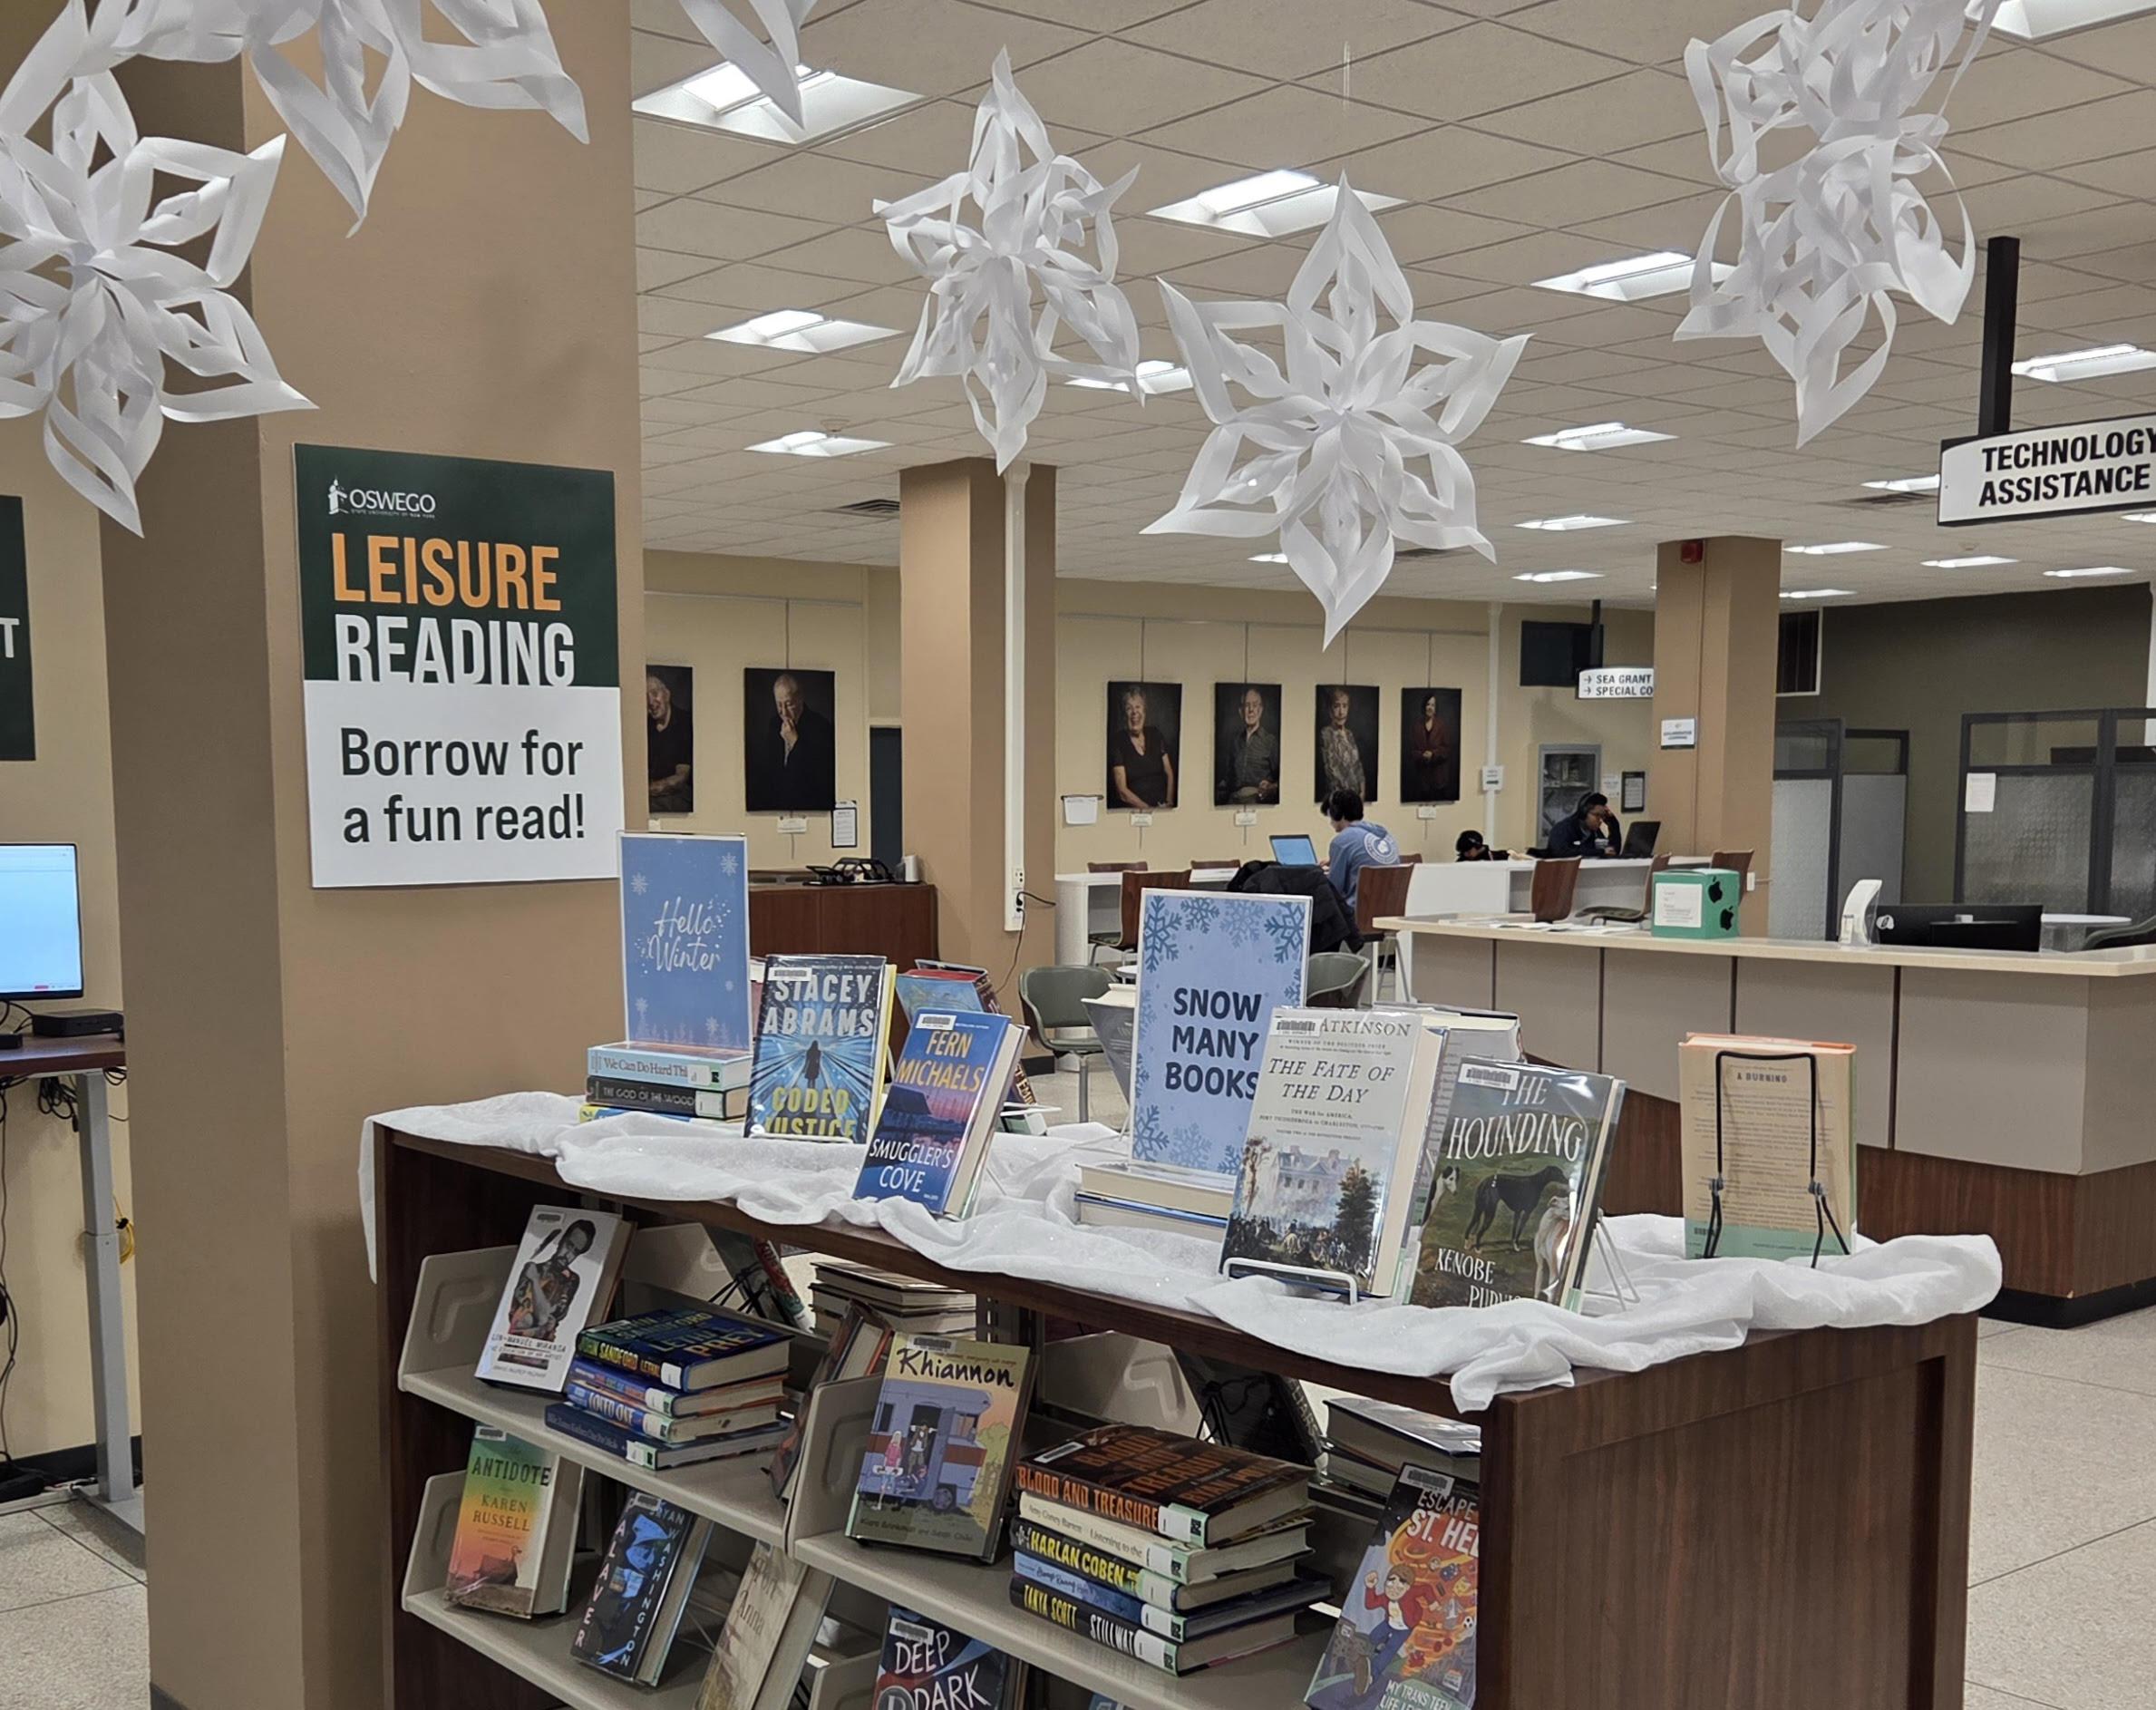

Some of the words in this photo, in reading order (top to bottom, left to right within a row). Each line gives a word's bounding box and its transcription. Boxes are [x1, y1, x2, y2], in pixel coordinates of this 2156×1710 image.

[349, 489, 436, 513] OSWEGO
[1978, 463, 2151, 507] ASSISTANCE
[332, 532, 561, 611] LEISURE
[335, 613, 575, 687] READING
[1596, 675, 1615, 685] SEA
[1618, 674, 1652, 685] GRANT
[1596, 686, 1636, 696] SPECIAL
[341, 727, 509, 776] Borrow
[520, 729, 584, 776] for
[343, 807, 370, 843] a
[384, 793, 461, 842] fun
[475, 793, 585, 840] read!
[654, 896, 714, 938] Hello
[647, 934, 722, 973] Winter
[774, 974, 872, 1003] STACEY
[1173, 987, 1262, 1022] SNOW
[762, 1006, 875, 1036] ABRAMS
[1320, 1018, 1412, 1036] ATKINSON
[925, 1029, 973, 1058] FERN
[1172, 1025, 1259, 1061] MANY
[603, 1057, 617, 1069] We
[618, 1058, 636, 1071] Can
[636, 1060, 649, 1072] Do
[650, 1063, 672, 1075] Hard
[895, 1058, 985, 1092] MICHAELS
[1164, 1061, 1260, 1101] BOOKS
[1268, 1058, 1306, 1075] THE
[1312, 1060, 1361, 1079] FATE
[1367, 1066, 1395, 1082] OF
[616, 1088, 636, 1100] GOD
[1282, 1083, 1320, 1100] THE
[1326, 1084, 1369, 1103] DAY
[869, 1138, 954, 1169] SMUGGLER'S
[1446, 1112, 1584, 1161] HOUNDING
[879, 1165, 926, 1193] COVE
[1434, 1248, 1496, 1285] XENOBE
[684, 1326, 765, 1356] PREY
[471, 1456, 552, 1487] ANTIDOTE
[481, 1494, 529, 1513] KAREN
[1016, 1465, 1060, 1499] BLOOD
[1063, 1480, 1089, 1508] AND
[1093, 1489, 1160, 1530] TREASURE
[1417, 1489, 1478, 1521] ESCAPE
[472, 1511, 530, 1531] RUSSELL
[1407, 1508, 1441, 1542] ST.
[1030, 1530, 1080, 1569] HARLAN
[1082, 1552, 1125, 1588] COBEN
[1024, 1584, 1048, 1616] TANYA
[1051, 1597, 1078, 1629] SCOTT
[895, 1630, 950, 1674] DEEP
[914, 1664, 992, 1710] DARK
